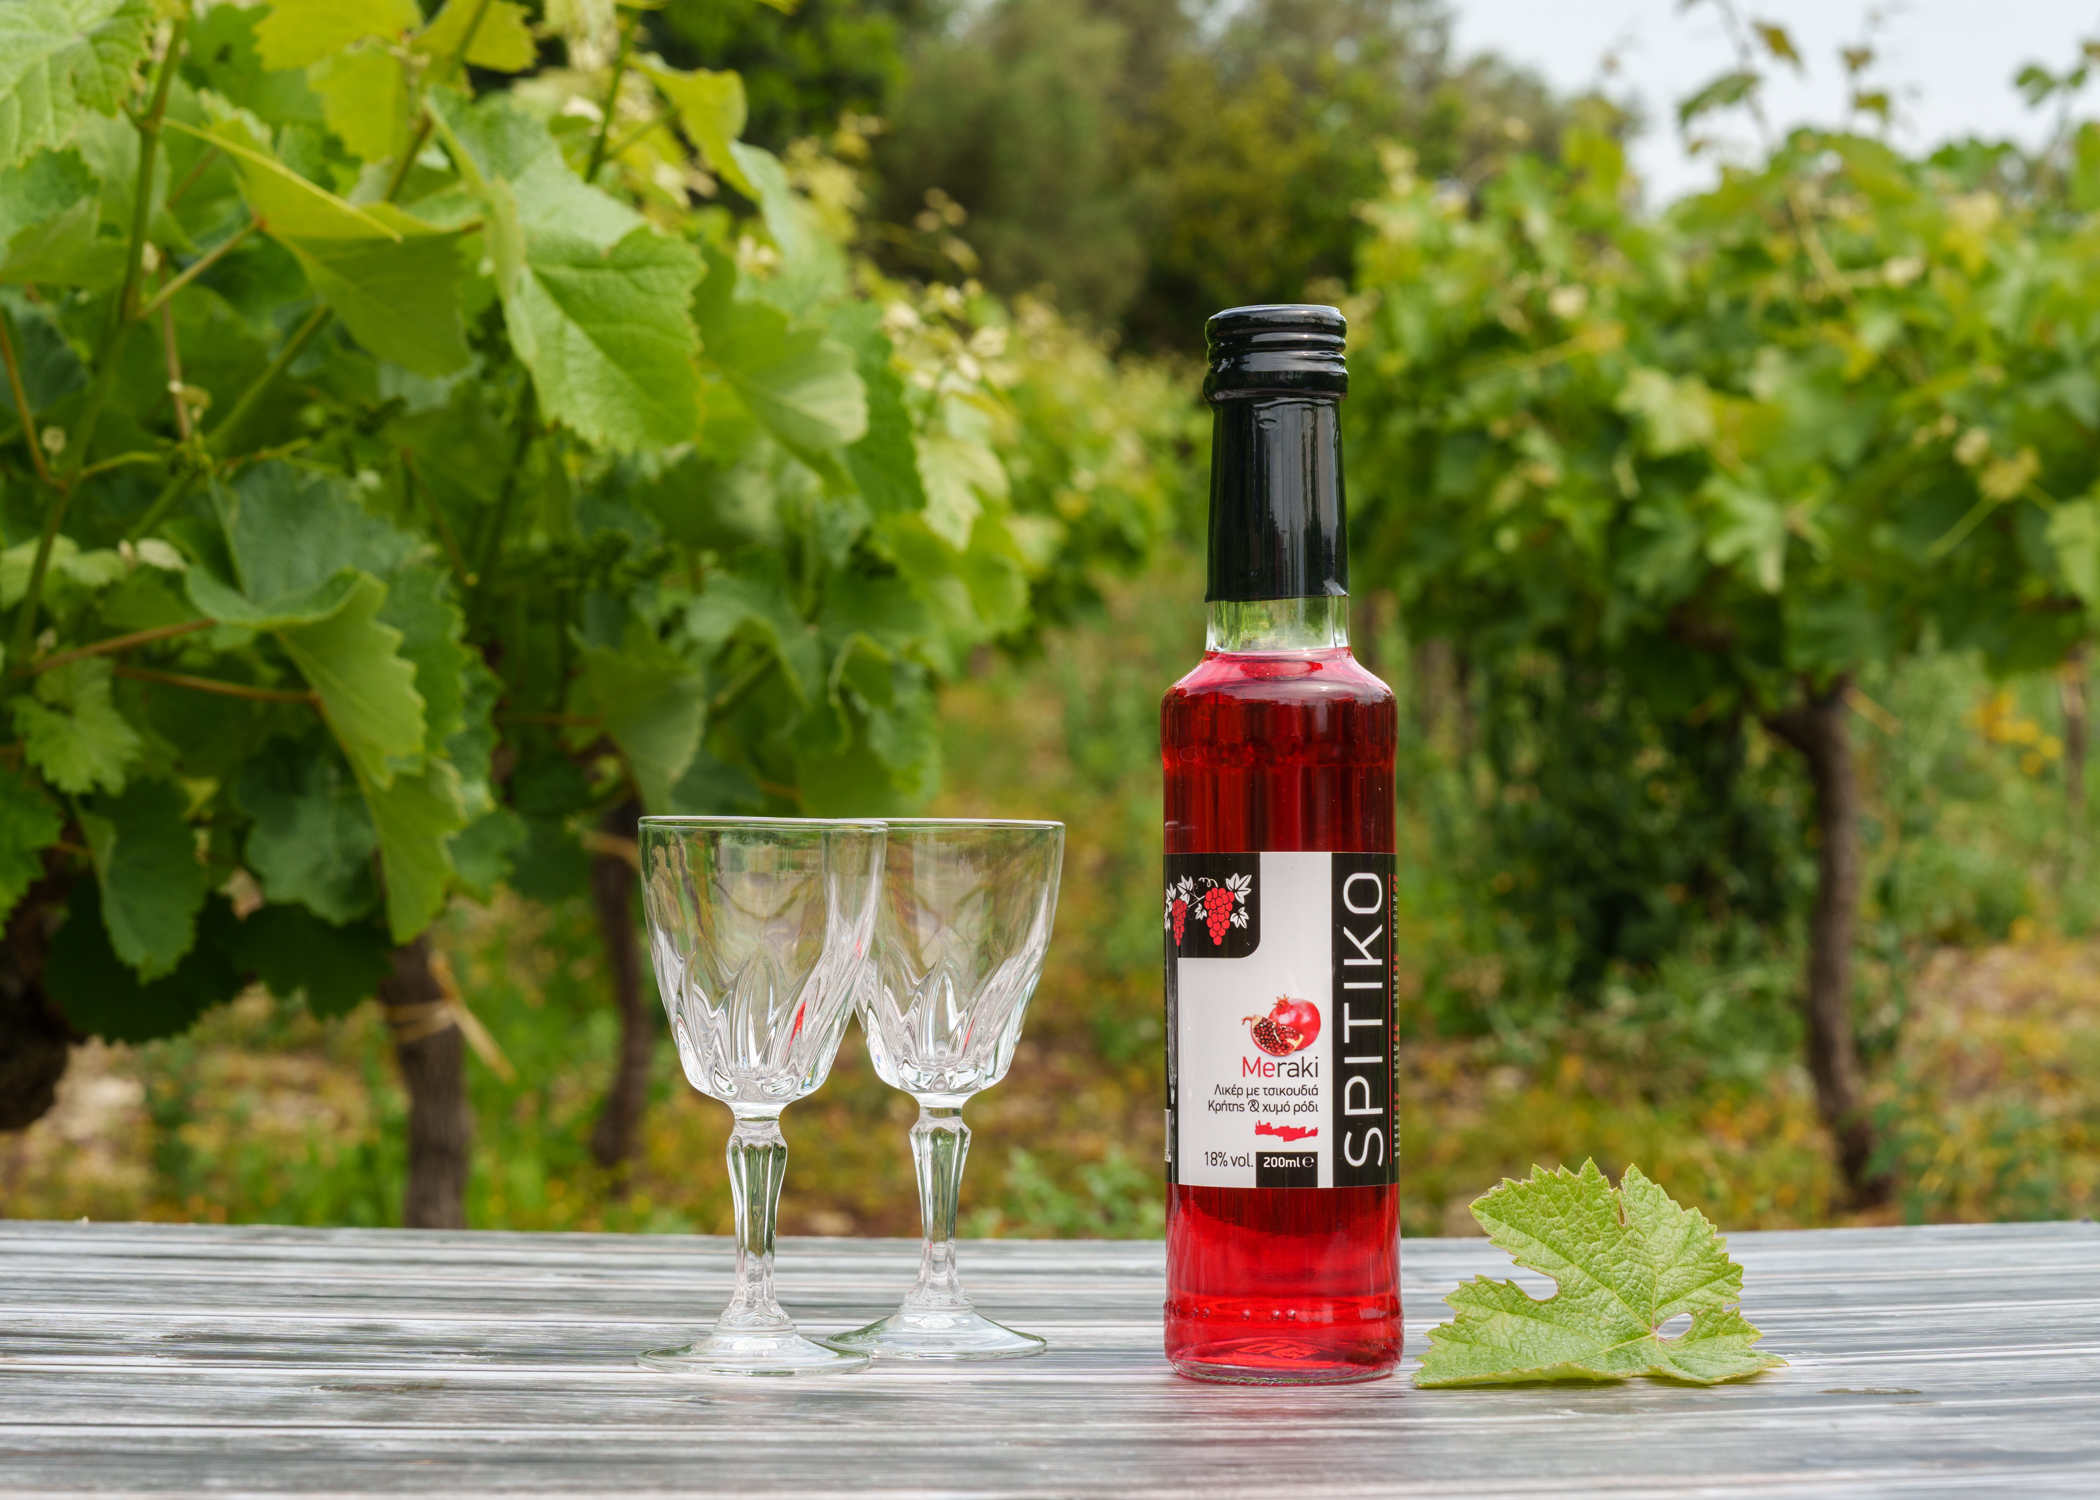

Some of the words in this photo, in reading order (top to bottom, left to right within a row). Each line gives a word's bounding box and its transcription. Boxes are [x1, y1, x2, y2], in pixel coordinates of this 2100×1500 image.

[1342, 872, 1384, 1167] SPITIKO
[1242, 1056, 1319, 1078] Meraki
[1214, 1084, 1243, 1098] Λικέρ
[1246, 1088, 1260, 1099] με
[1263, 1084, 1319, 1096] τσικουδιά
[1208, 1099, 1245, 1114] Κρήτης
[1247, 1099, 1260, 1113] &
[1262, 1101, 1290, 1115] χυμό
[1293, 1100, 1319, 1115] ρόδι
[1204, 1151, 1228, 1167] 18%
[1230, 1152, 1254, 1168] vol.
[1263, 1156, 1301, 1168] 200ml
